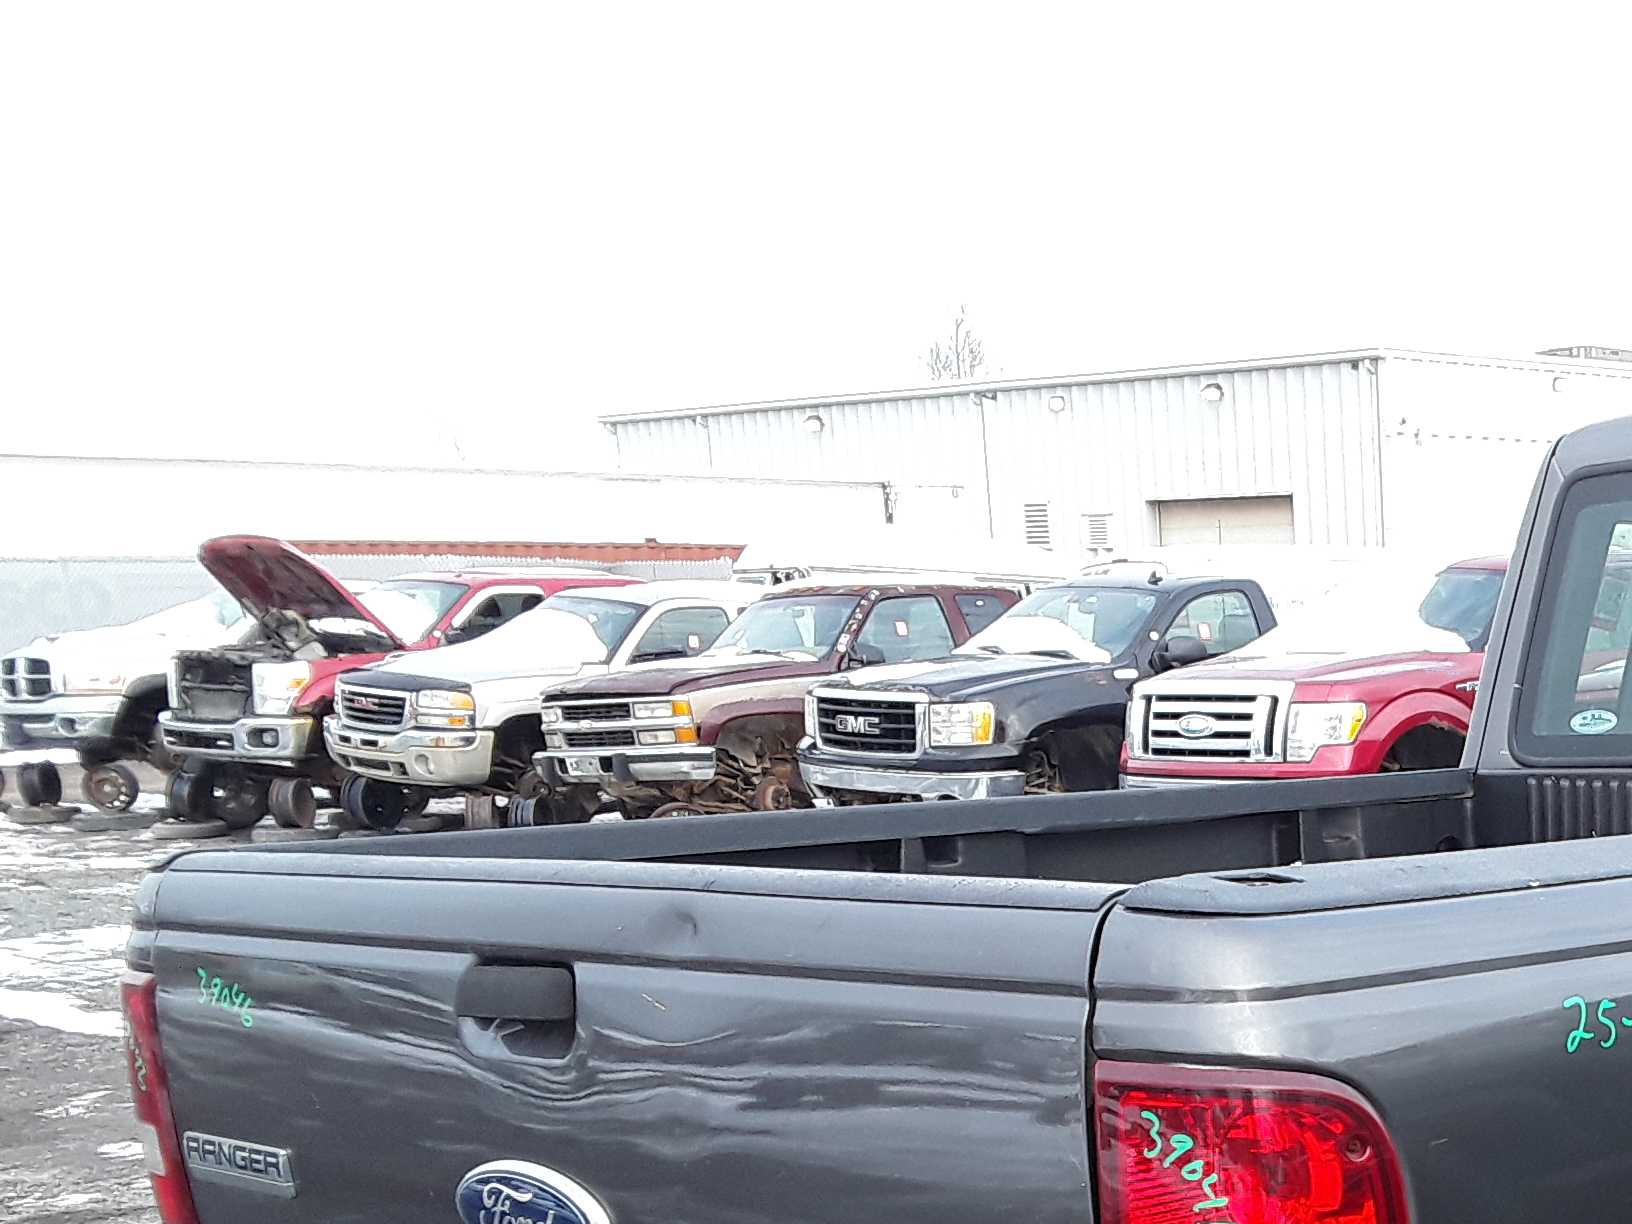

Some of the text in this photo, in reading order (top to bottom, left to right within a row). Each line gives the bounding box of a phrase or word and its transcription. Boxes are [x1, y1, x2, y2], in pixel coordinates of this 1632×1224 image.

[835, 714, 880, 735] GMC
[197, 967, 254, 1027] 39046
[185, 1136, 283, 1178] RANGER
